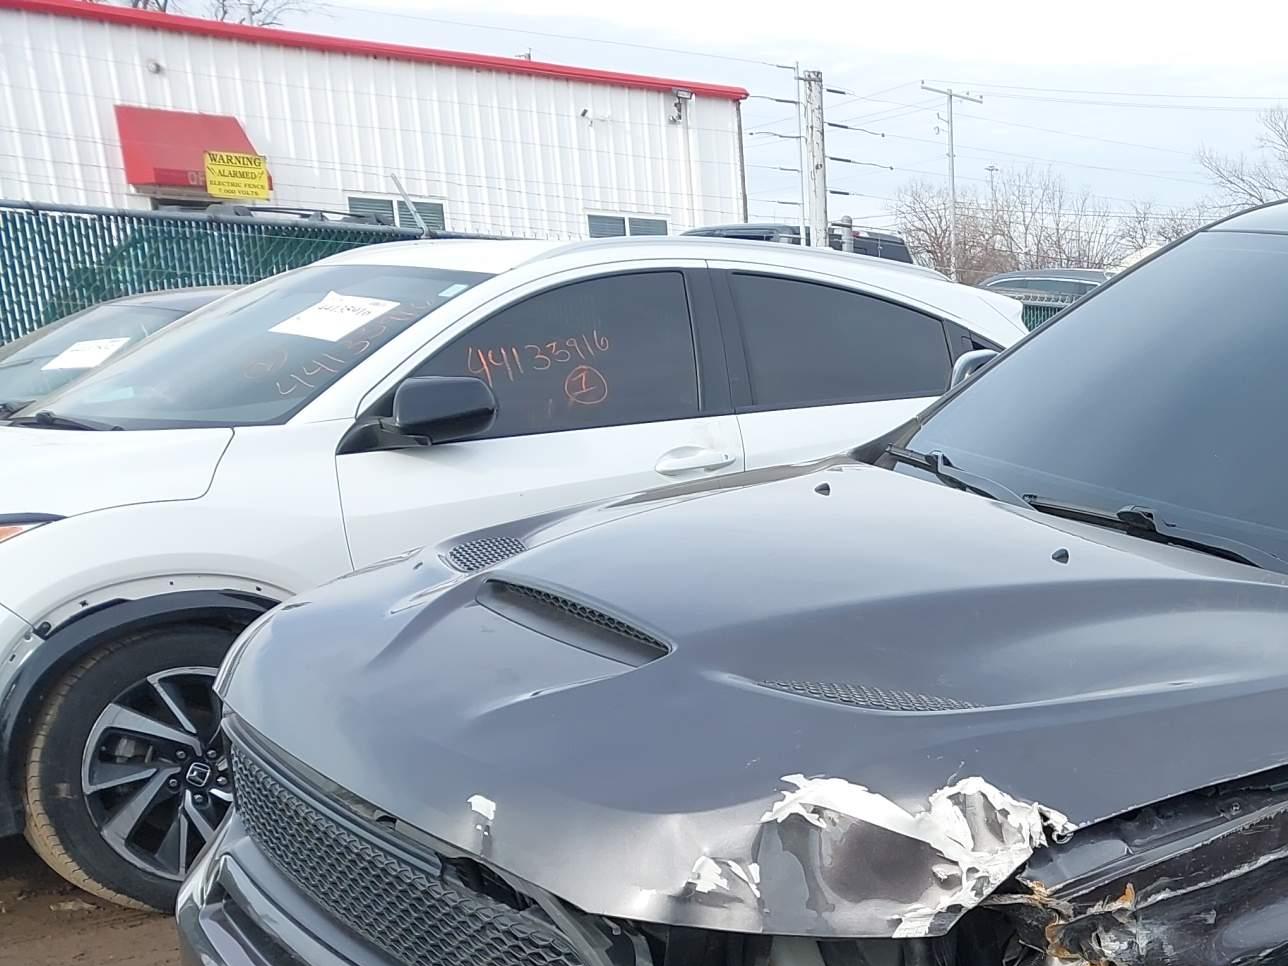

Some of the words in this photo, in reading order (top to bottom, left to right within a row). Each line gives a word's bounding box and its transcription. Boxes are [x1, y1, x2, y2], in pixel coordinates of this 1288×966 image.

[208, 153, 262, 167] WARNING
[217, 169, 257, 180] ALARMED
[209, 180, 241, 188] ELECTRIC
[467, 330, 609, 388] 44133916
